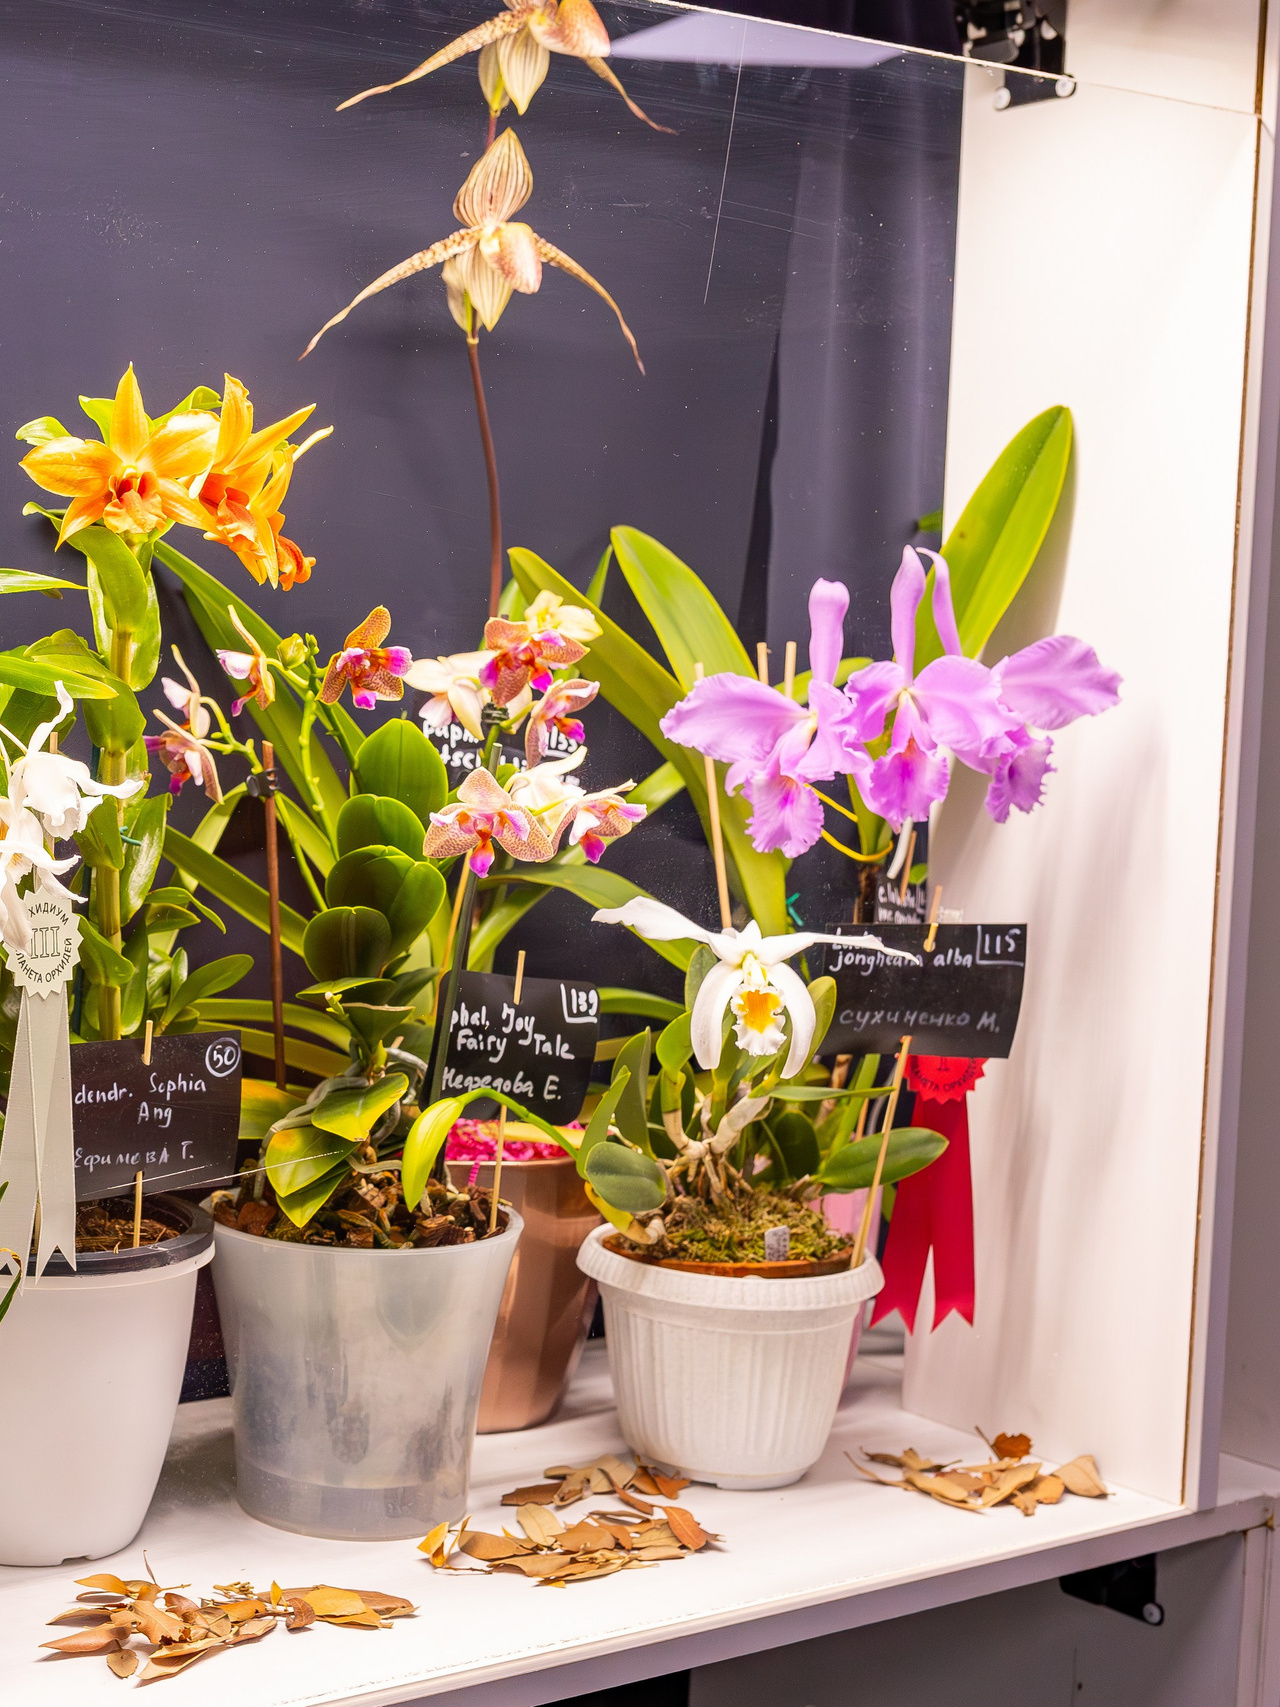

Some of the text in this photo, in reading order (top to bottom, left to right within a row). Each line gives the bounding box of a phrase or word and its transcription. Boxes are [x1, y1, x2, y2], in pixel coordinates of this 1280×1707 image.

[27, 902, 70, 926] ХИДИУМ
[31, 926, 61, 960] III
[984, 928, 1021, 955] 115
[15, 937, 73, 984] ЛАНЕТА ОРХИДЕЙ
[933, 948, 973, 968] alba
[571, 988, 598, 1016] 139
[502, 1002, 535, 1046] Joy
[457, 1028, 576, 1064] Fairy Tale
[74, 1072, 207, 1105] dendr. Sophia
[543, 1075, 562, 1100] Е.
[137, 1101, 173, 1129] Ang
